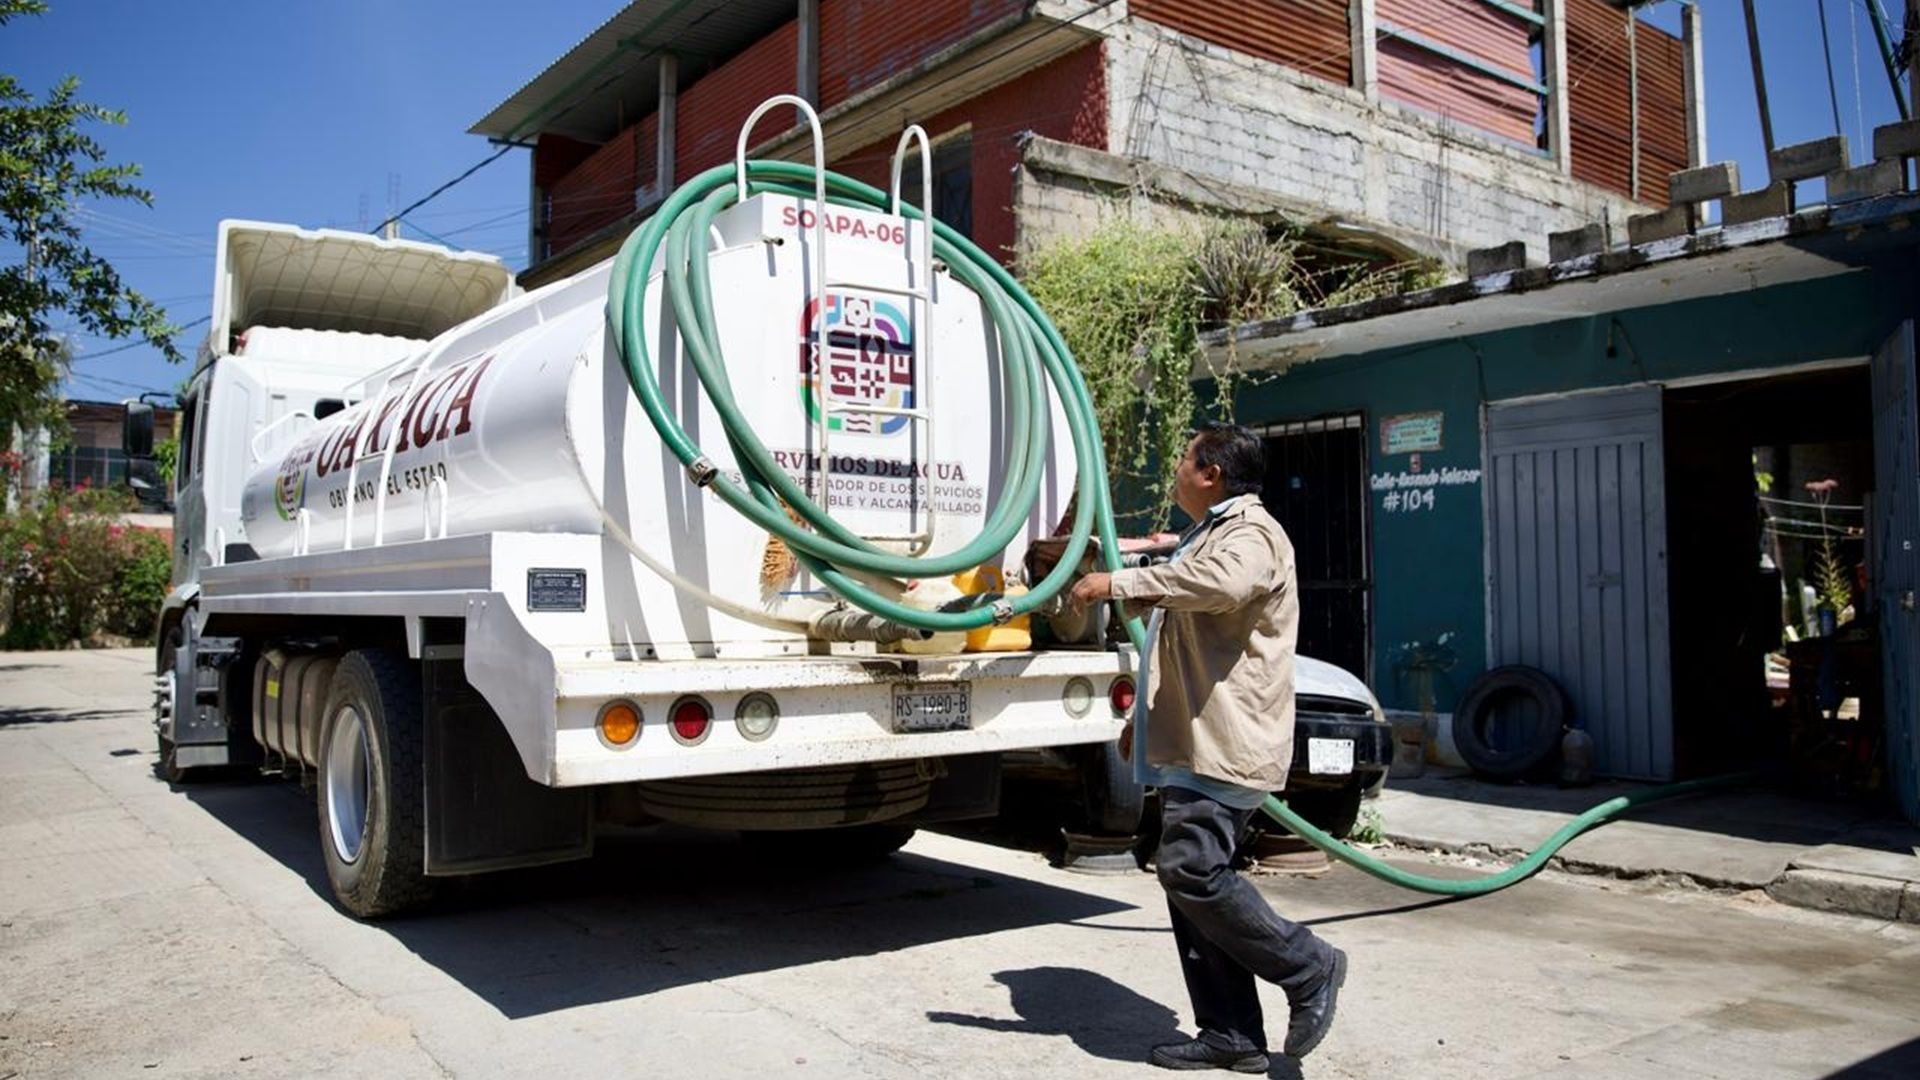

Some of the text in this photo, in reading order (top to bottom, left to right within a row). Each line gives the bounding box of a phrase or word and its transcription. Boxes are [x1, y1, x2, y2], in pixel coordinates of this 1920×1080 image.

[783, 206, 905, 245] SOAPA-06
[768, 450, 868, 475] RVIIOS
[875, 459, 902, 478] DE
[378, 475, 401, 495] EL
[869, 481, 886, 493] DE
[891, 483, 915, 496] LOS
[919, 485, 983, 499] SRVICIOS
[859, 496, 867, 507] Y
[870, 497, 982, 514] ALCANTAILLADO
[1382, 488, 1435, 512] #104
